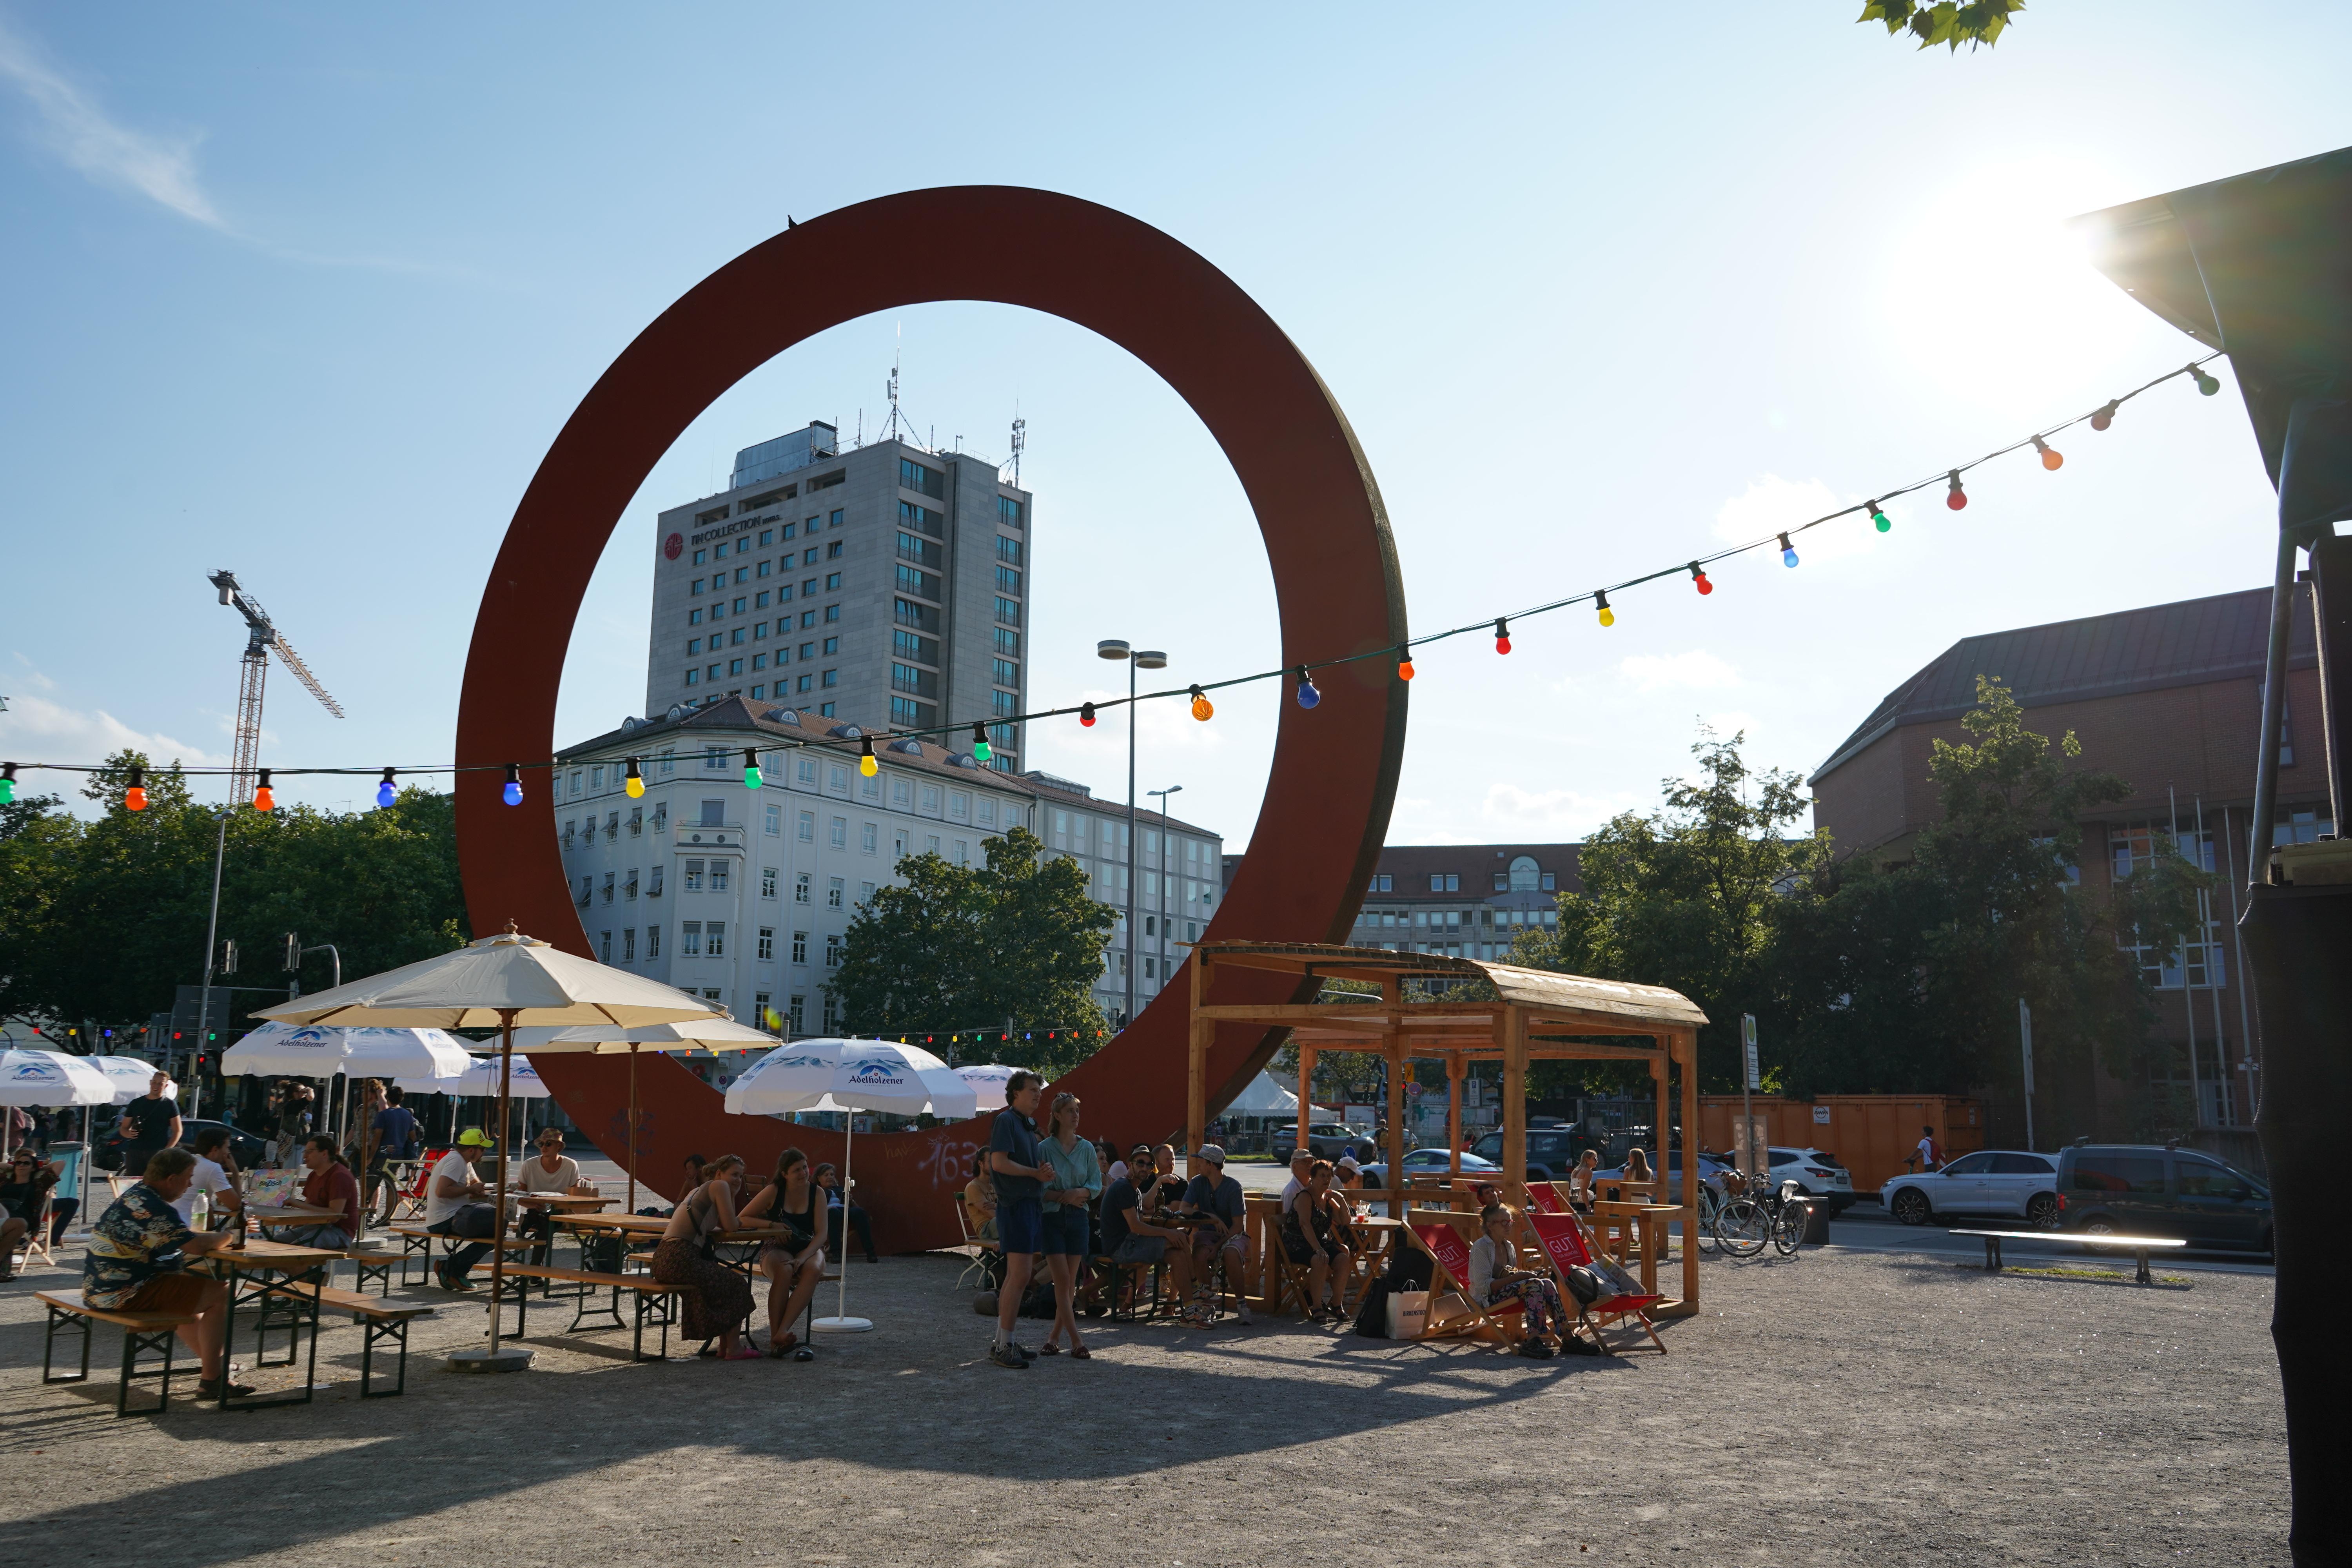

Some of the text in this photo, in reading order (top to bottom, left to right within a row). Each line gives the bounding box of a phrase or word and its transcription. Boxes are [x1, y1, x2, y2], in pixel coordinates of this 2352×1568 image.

[705, 515, 761, 541] COLLECTION
[762, 514, 780, 524] HOTELS
[274, 1039, 328, 1048] Adelholzener
[848, 1075, 904, 1084] Adelholzener
[1549, 1236, 1574, 1253] GUT
[1437, 1246, 1459, 1262] GUT
